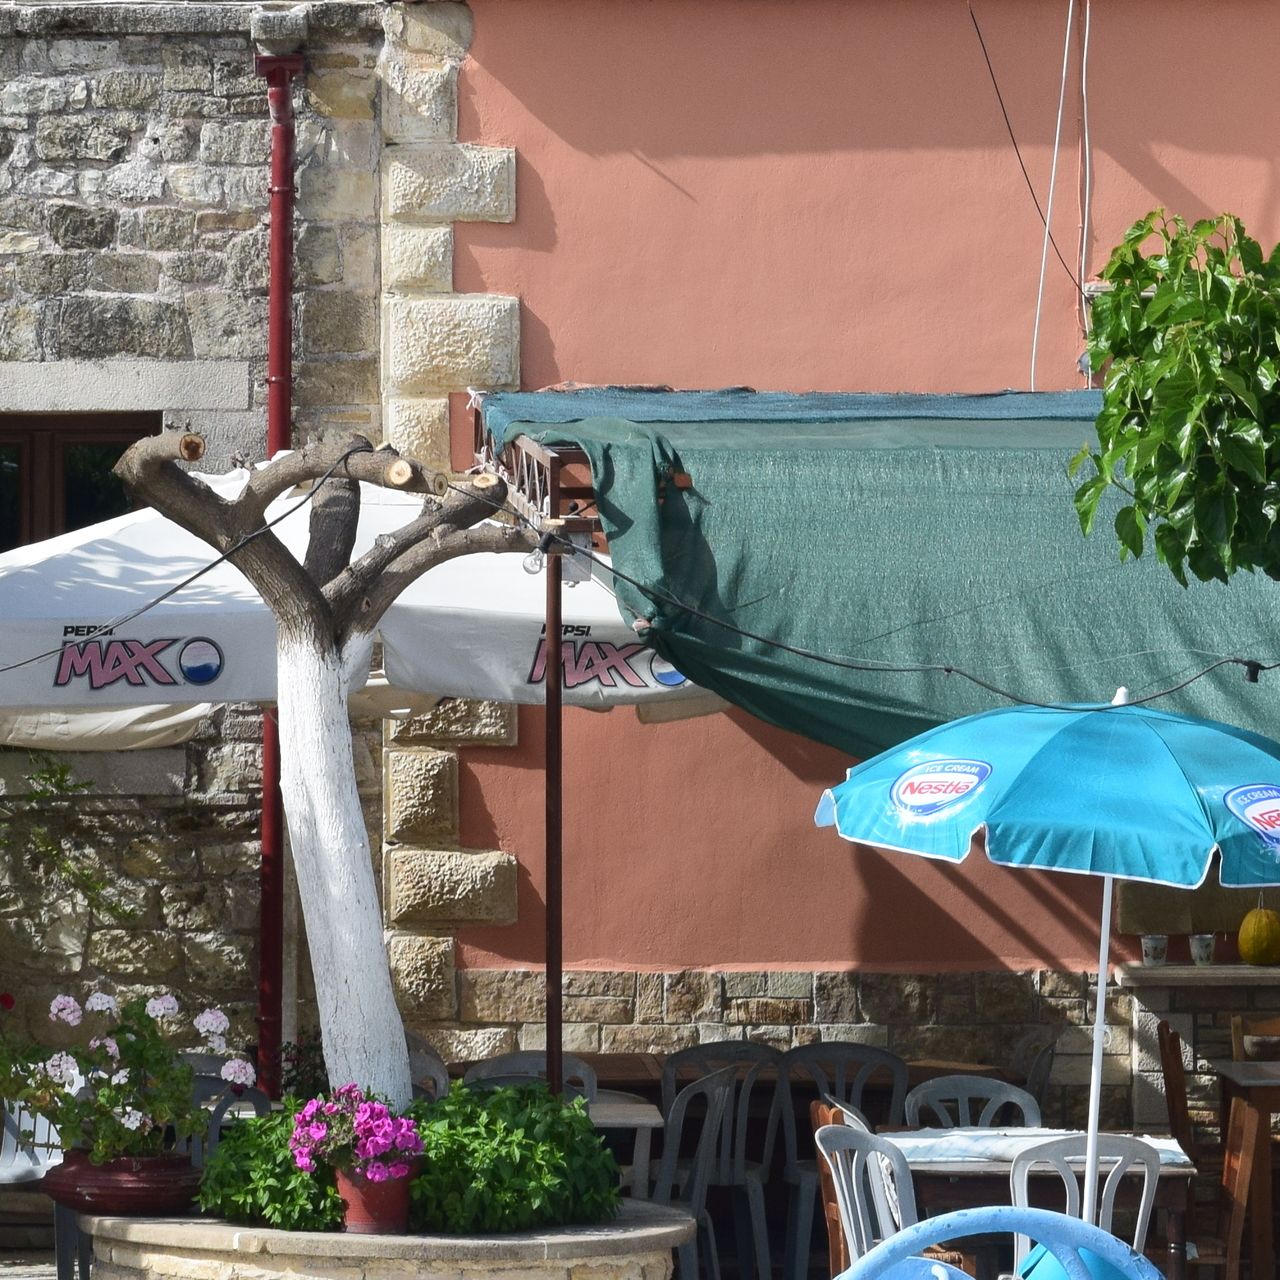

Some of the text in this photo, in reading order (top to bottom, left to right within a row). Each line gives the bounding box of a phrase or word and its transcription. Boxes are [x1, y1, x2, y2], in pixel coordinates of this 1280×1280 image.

[53, 637, 183, 689] MAX
[527, 637, 650, 688] MAX
[945, 765, 979, 773] CREAM
[902, 780, 974, 795] Nestlé
[1250, 789, 1280, 801] CREAM
